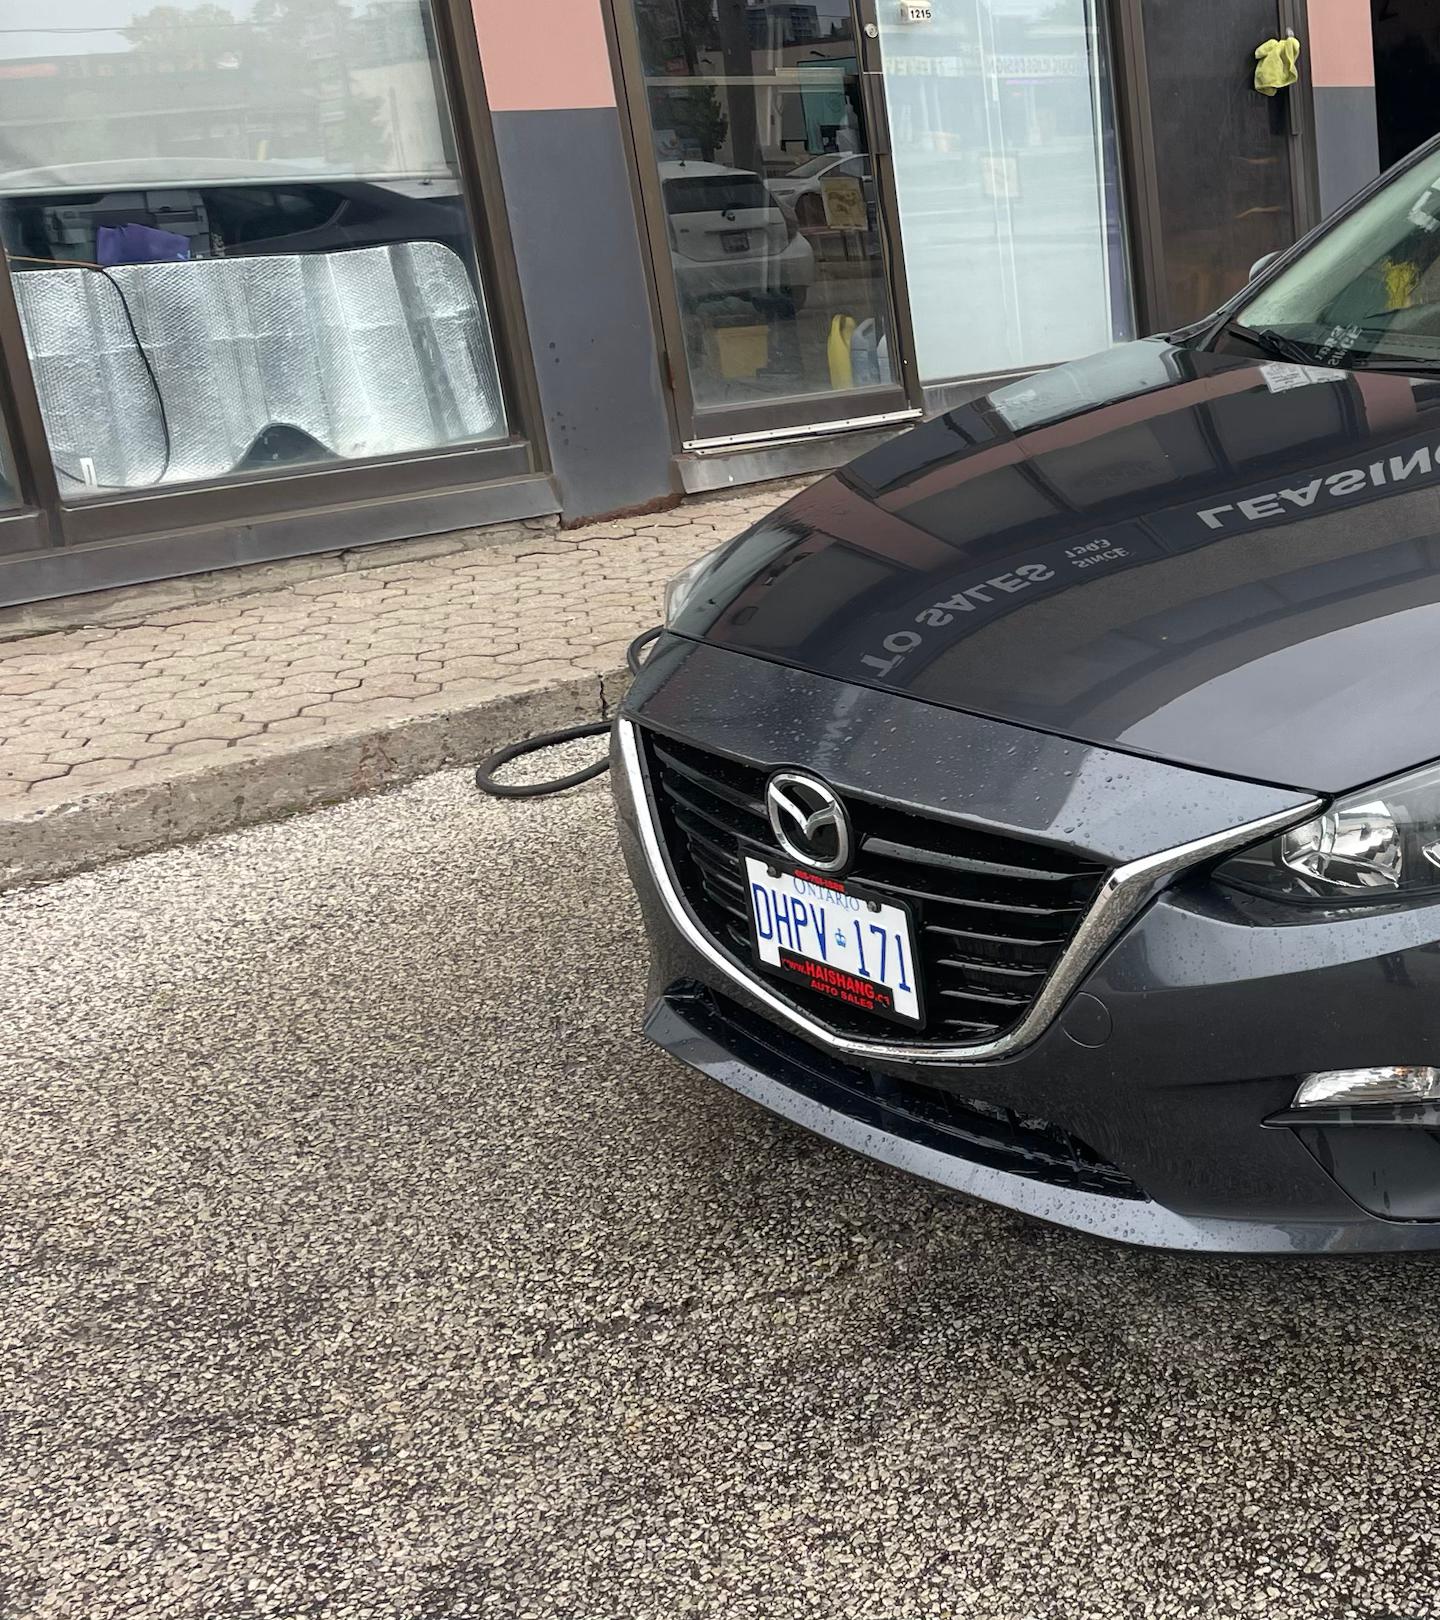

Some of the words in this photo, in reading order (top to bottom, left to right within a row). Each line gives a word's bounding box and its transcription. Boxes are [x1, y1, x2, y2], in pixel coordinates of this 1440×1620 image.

[910, 9, 932, 19] 1215
[752, 883, 827, 961] DHPV
[853, 920, 911, 993] 171
[811, 980, 838, 997] AUTO
[840, 991, 874, 1010] SALES
